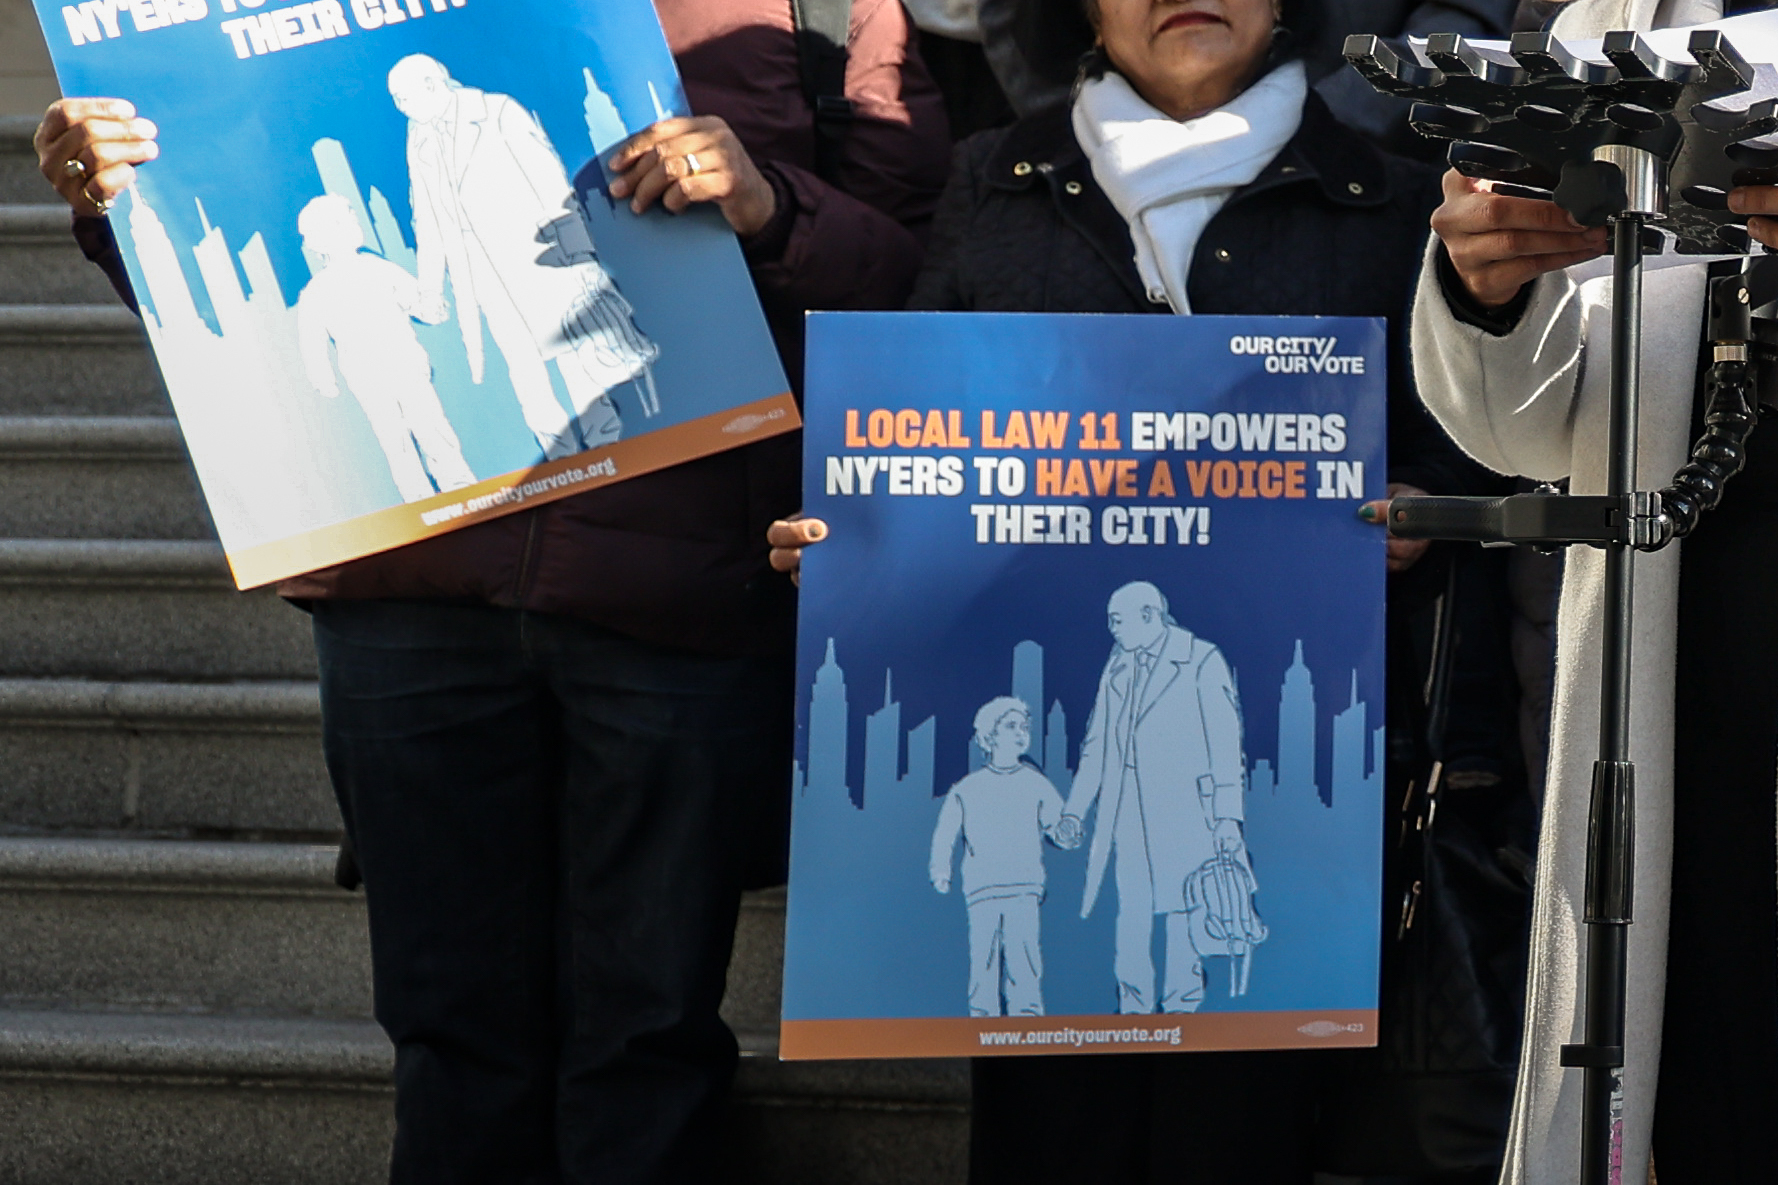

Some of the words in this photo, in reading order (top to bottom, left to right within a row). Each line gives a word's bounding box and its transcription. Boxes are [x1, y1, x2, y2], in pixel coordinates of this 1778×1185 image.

[1230, 336, 1274, 355] OUR
[1265, 355, 1308, 374] OUR
[1309, 348, 1365, 374] VOTE
[845, 408, 971, 449] LOCAL
[981, 410, 1070, 450] LAW
[1078, 411, 1122, 450] 11
[1131, 411, 1347, 452] EMPOWERS
[420, 456, 617, 527] www.ourcityourvote.org
[825, 455, 965, 496] NY'ERS
[973, 456, 1027, 497] TO
[1035, 457, 1138, 497] HAVE
[1148, 460, 1176, 498] A
[1185, 460, 1307, 499] VOICE
[1316, 460, 1364, 499] IN
[970, 504, 1092, 544] THEIR
[1101, 505, 1211, 545] CITY!
[979, 1025, 1181, 1047] www.ourcityourvote.org
